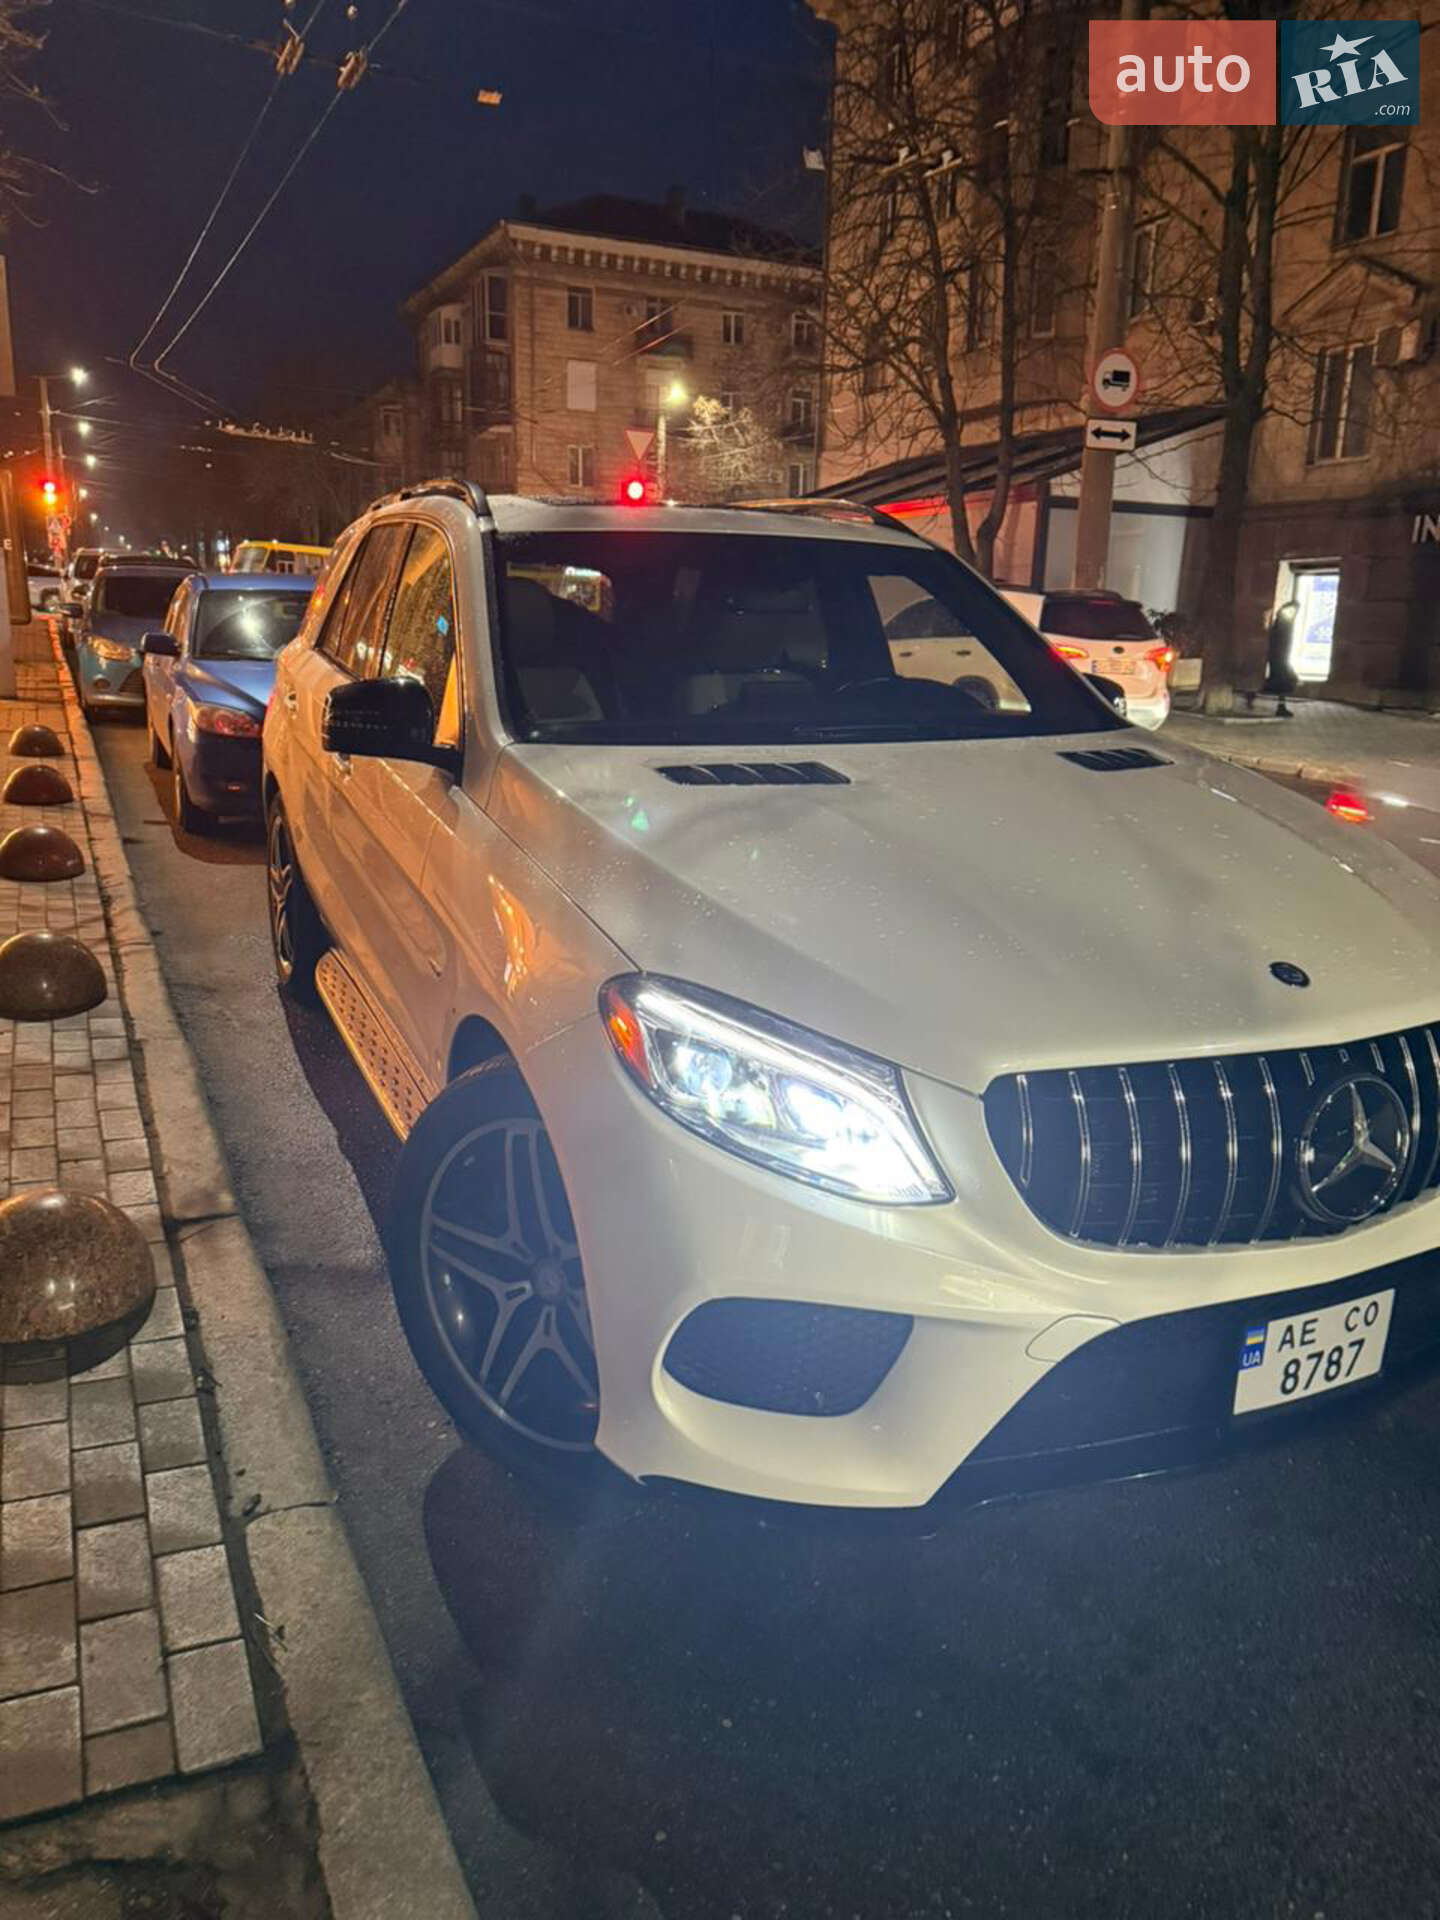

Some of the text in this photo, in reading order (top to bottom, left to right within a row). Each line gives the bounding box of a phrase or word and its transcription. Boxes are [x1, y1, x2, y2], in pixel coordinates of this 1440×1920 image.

[1277, 1300, 1379, 1353] AE CO
[1242, 1351, 1262, 1367] UA
[1280, 1337, 1366, 1396] 8787
